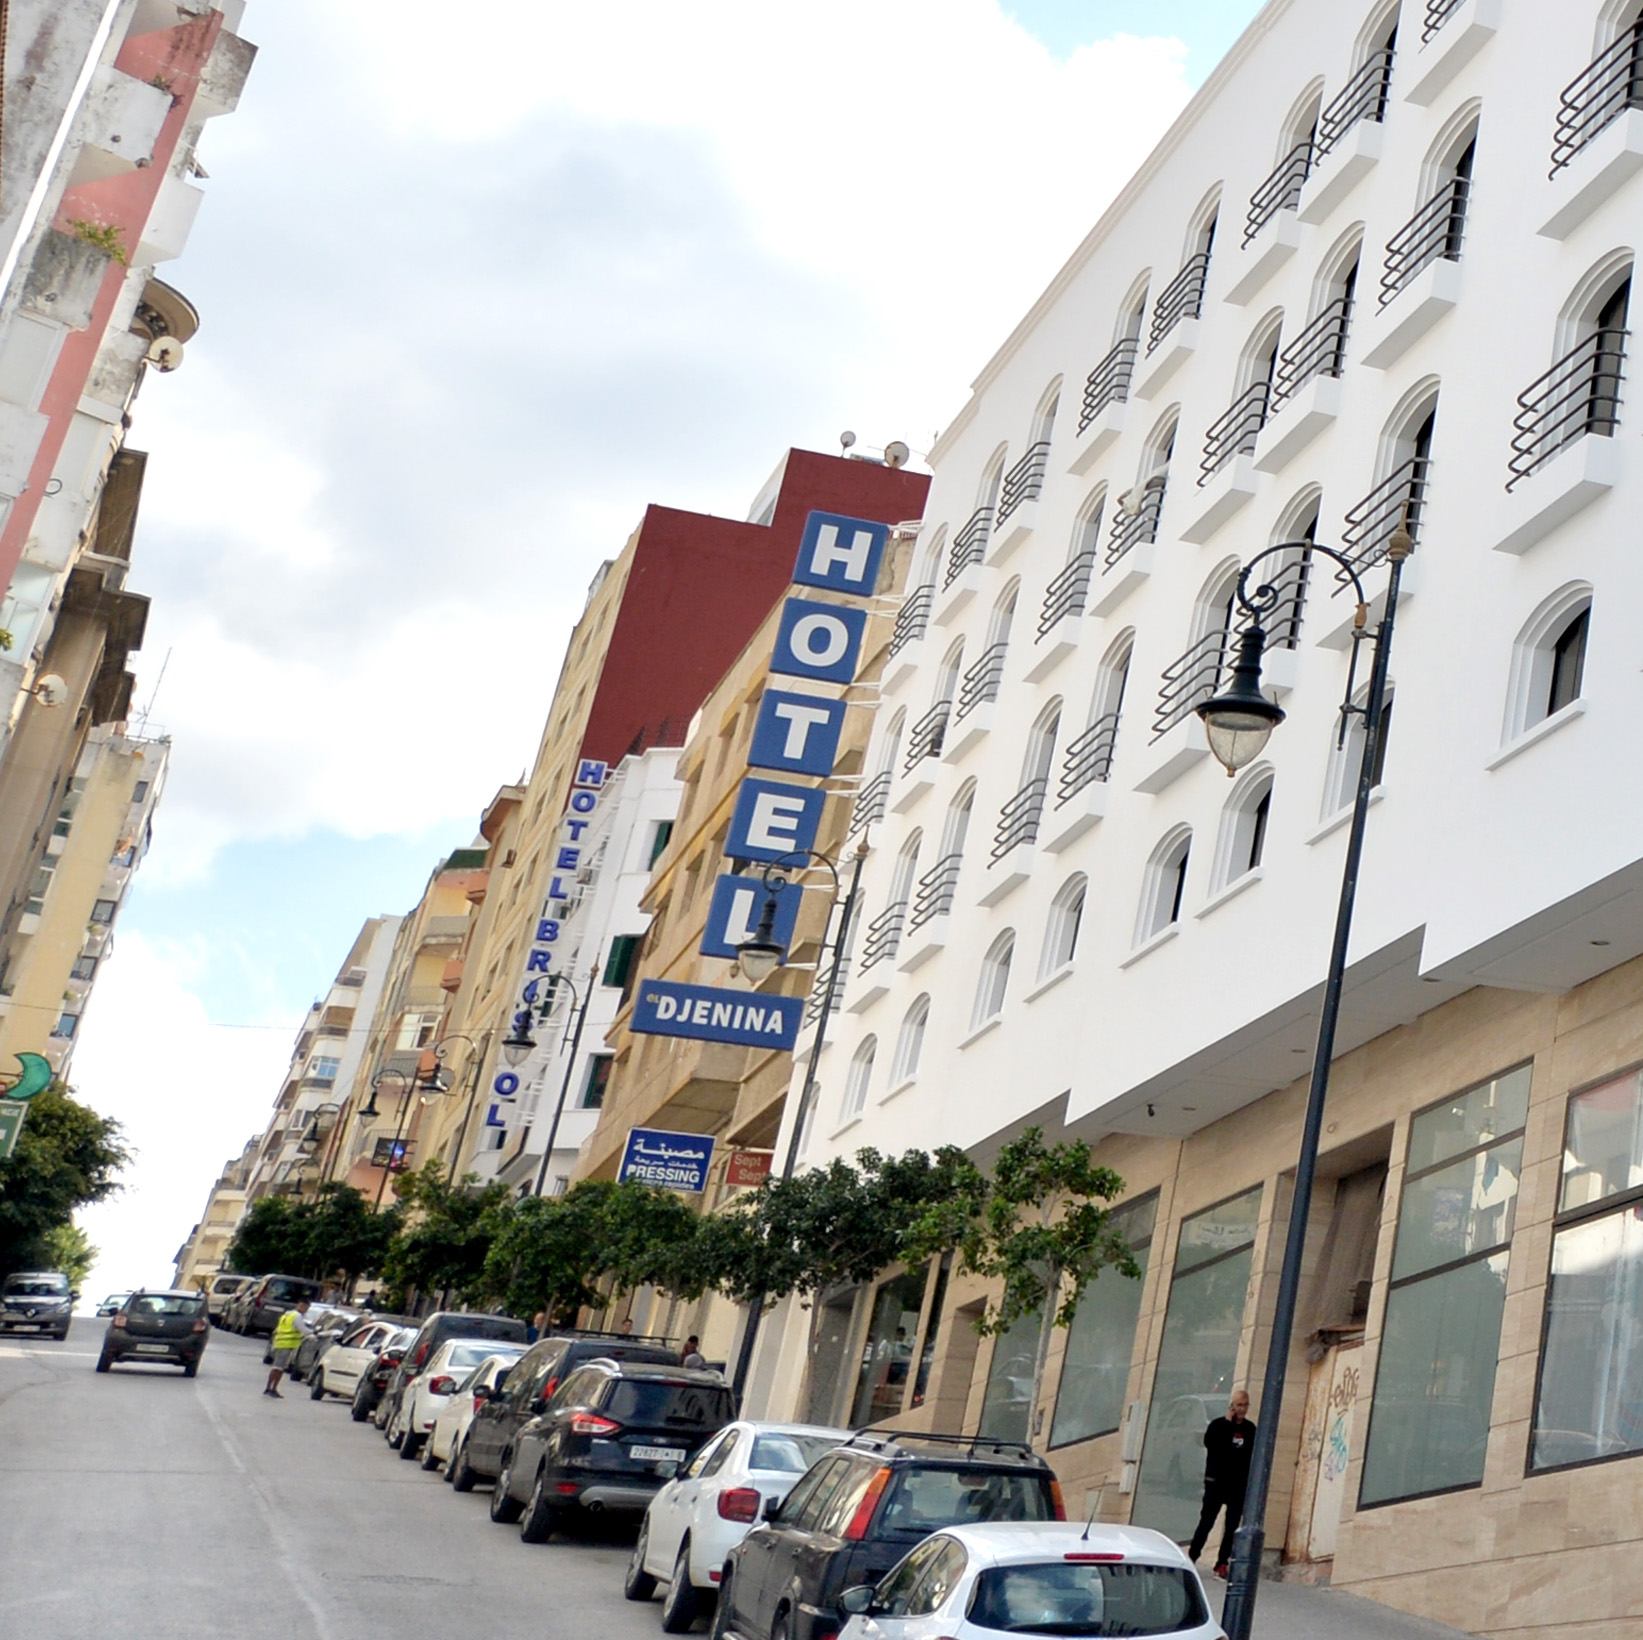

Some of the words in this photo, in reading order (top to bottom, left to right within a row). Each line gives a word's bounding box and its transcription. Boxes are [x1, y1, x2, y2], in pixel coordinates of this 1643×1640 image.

[723, 523, 873, 946] HOTEL
[549, 761, 605, 900] HOTEL
[486, 919, 559, 1127] BRISOL
[656, 995, 783, 1035] DJENINA
[626, 1164, 700, 1183] PRESSING
[734, 1154, 762, 1168] Sept
